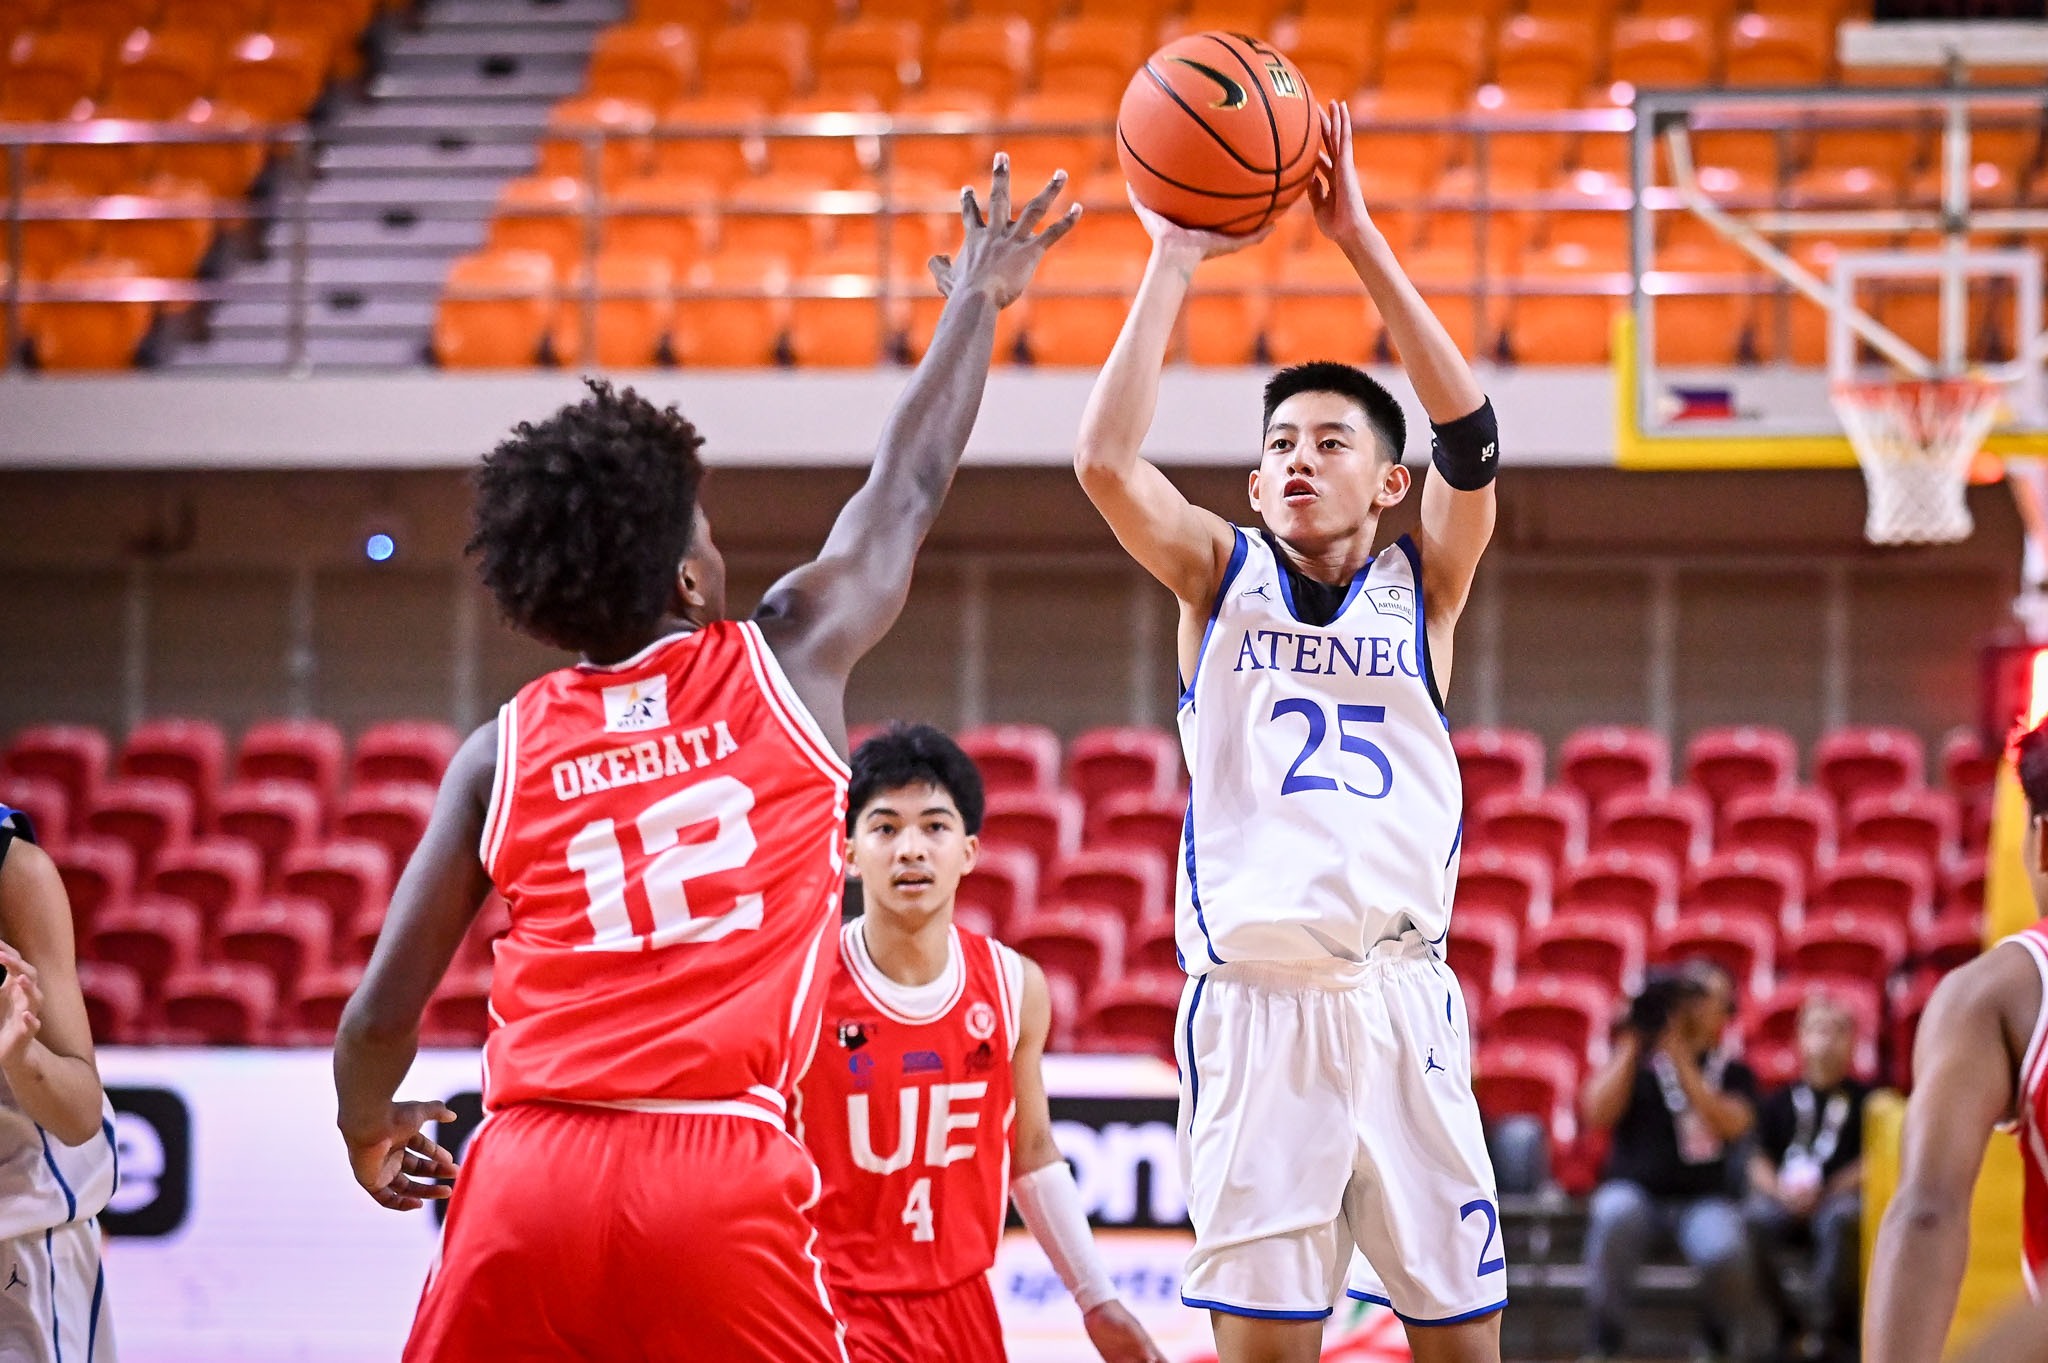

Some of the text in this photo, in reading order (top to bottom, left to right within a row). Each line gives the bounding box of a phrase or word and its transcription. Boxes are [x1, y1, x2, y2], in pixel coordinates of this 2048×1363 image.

[551, 720, 739, 801] OKEBATA
[1271, 697, 1393, 799] 25
[566, 775, 765, 952] 12
[847, 1081, 988, 1175] UE
[902, 1177, 935, 1242] 4
[1460, 1198, 1505, 1277] 2
